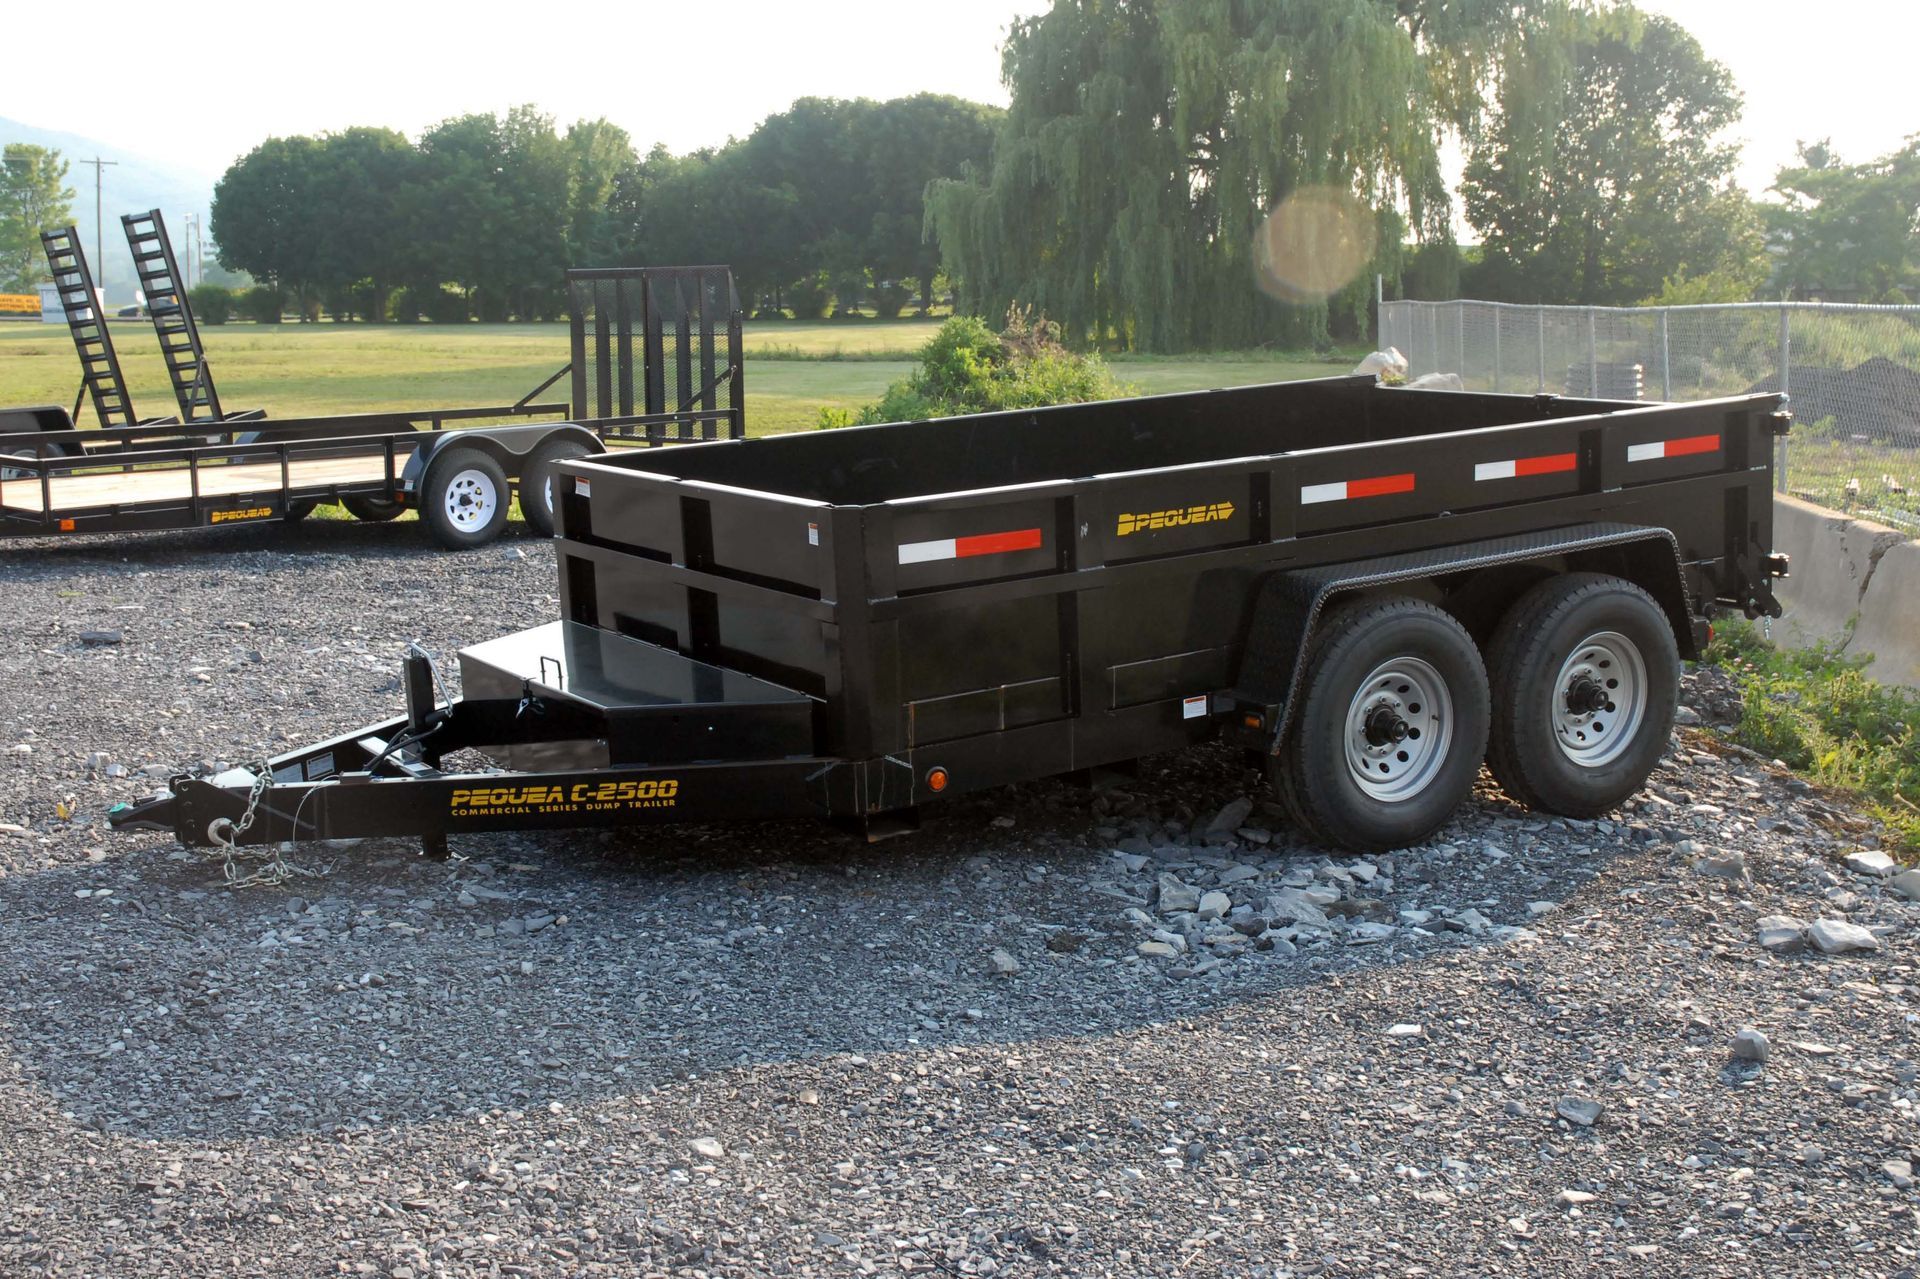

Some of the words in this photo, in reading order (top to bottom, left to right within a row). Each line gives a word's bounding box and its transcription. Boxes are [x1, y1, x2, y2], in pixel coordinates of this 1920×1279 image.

[1135, 504, 1218, 532] PEQUEA
[451, 785, 564, 807] PEQUEA
[570, 779, 679, 802] C-2500
[451, 806, 531, 817] COMMERCIAL
[538, 804, 578, 813] SERIES
[586, 802, 621, 811] DUMP
[628, 799, 676, 809] TRAILER
